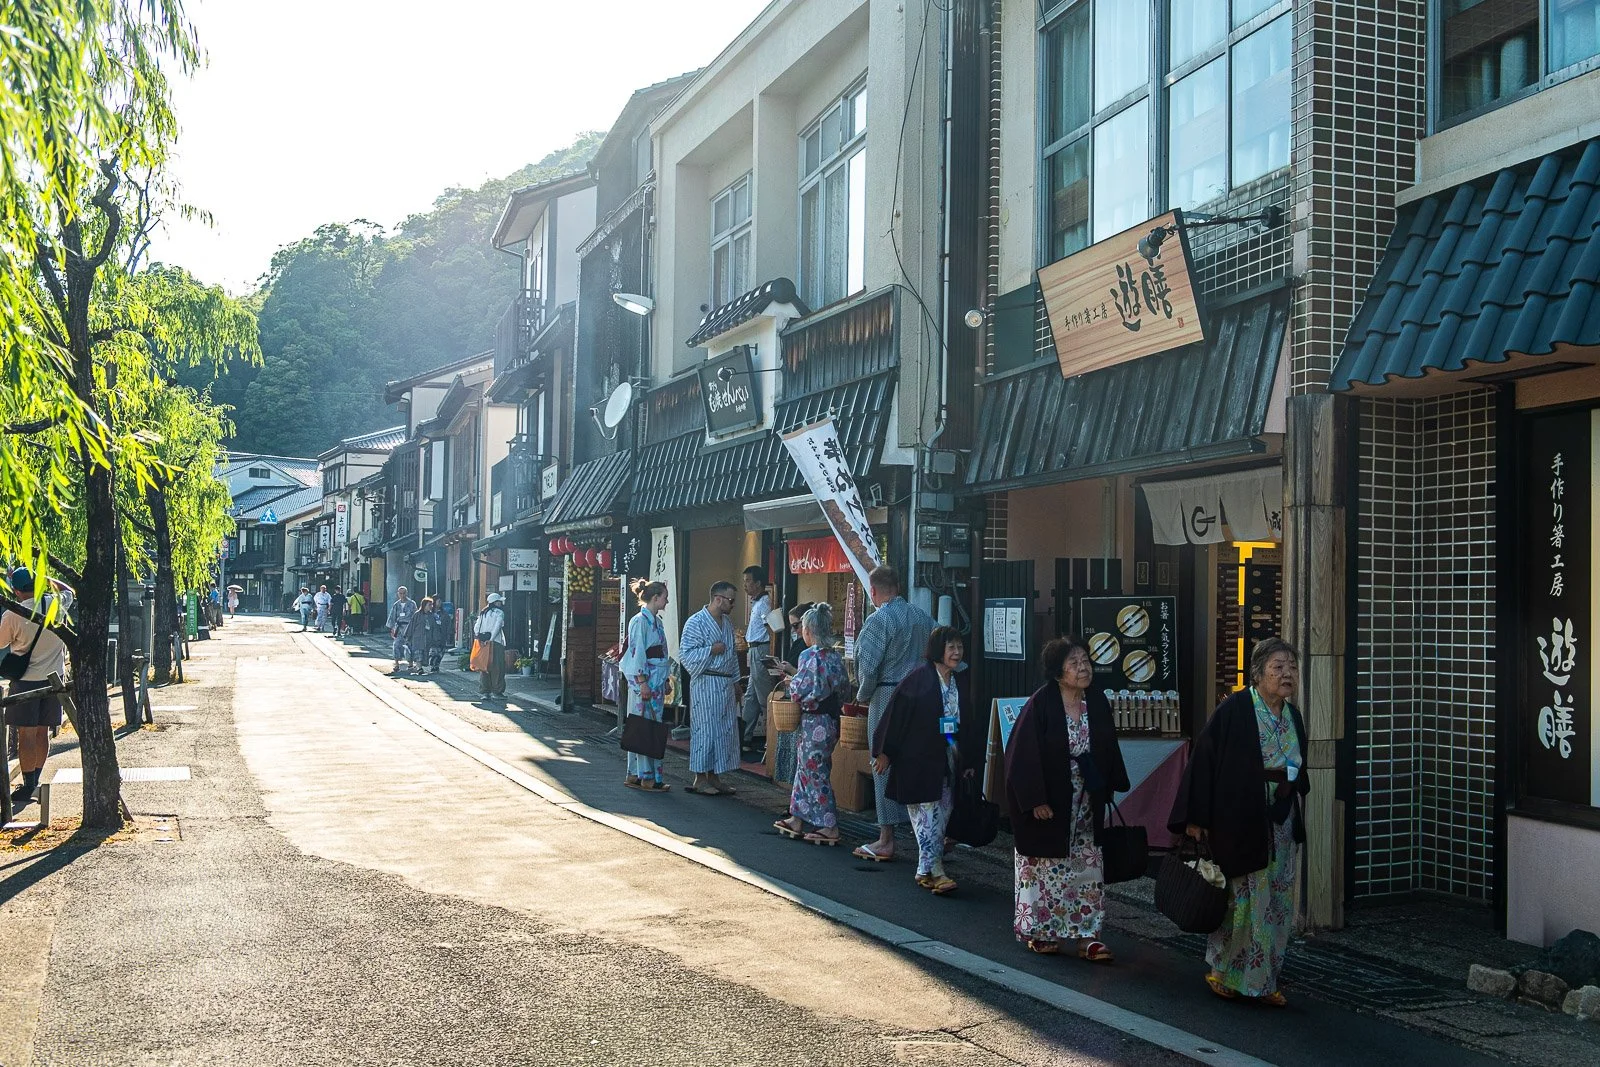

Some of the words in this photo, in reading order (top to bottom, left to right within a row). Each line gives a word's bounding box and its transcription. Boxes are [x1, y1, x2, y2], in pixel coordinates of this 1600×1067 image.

[1064, 302, 1108, 331] 手作り箸工房
[1110, 254, 1173, 332] 遊膳
[1550, 452, 1565, 597] 手作り箸工房
[1160, 601, 1170, 620] お箸
[1160, 623, 1171, 680] 人気ランキング
[1537, 616, 1578, 759] 遊膳
